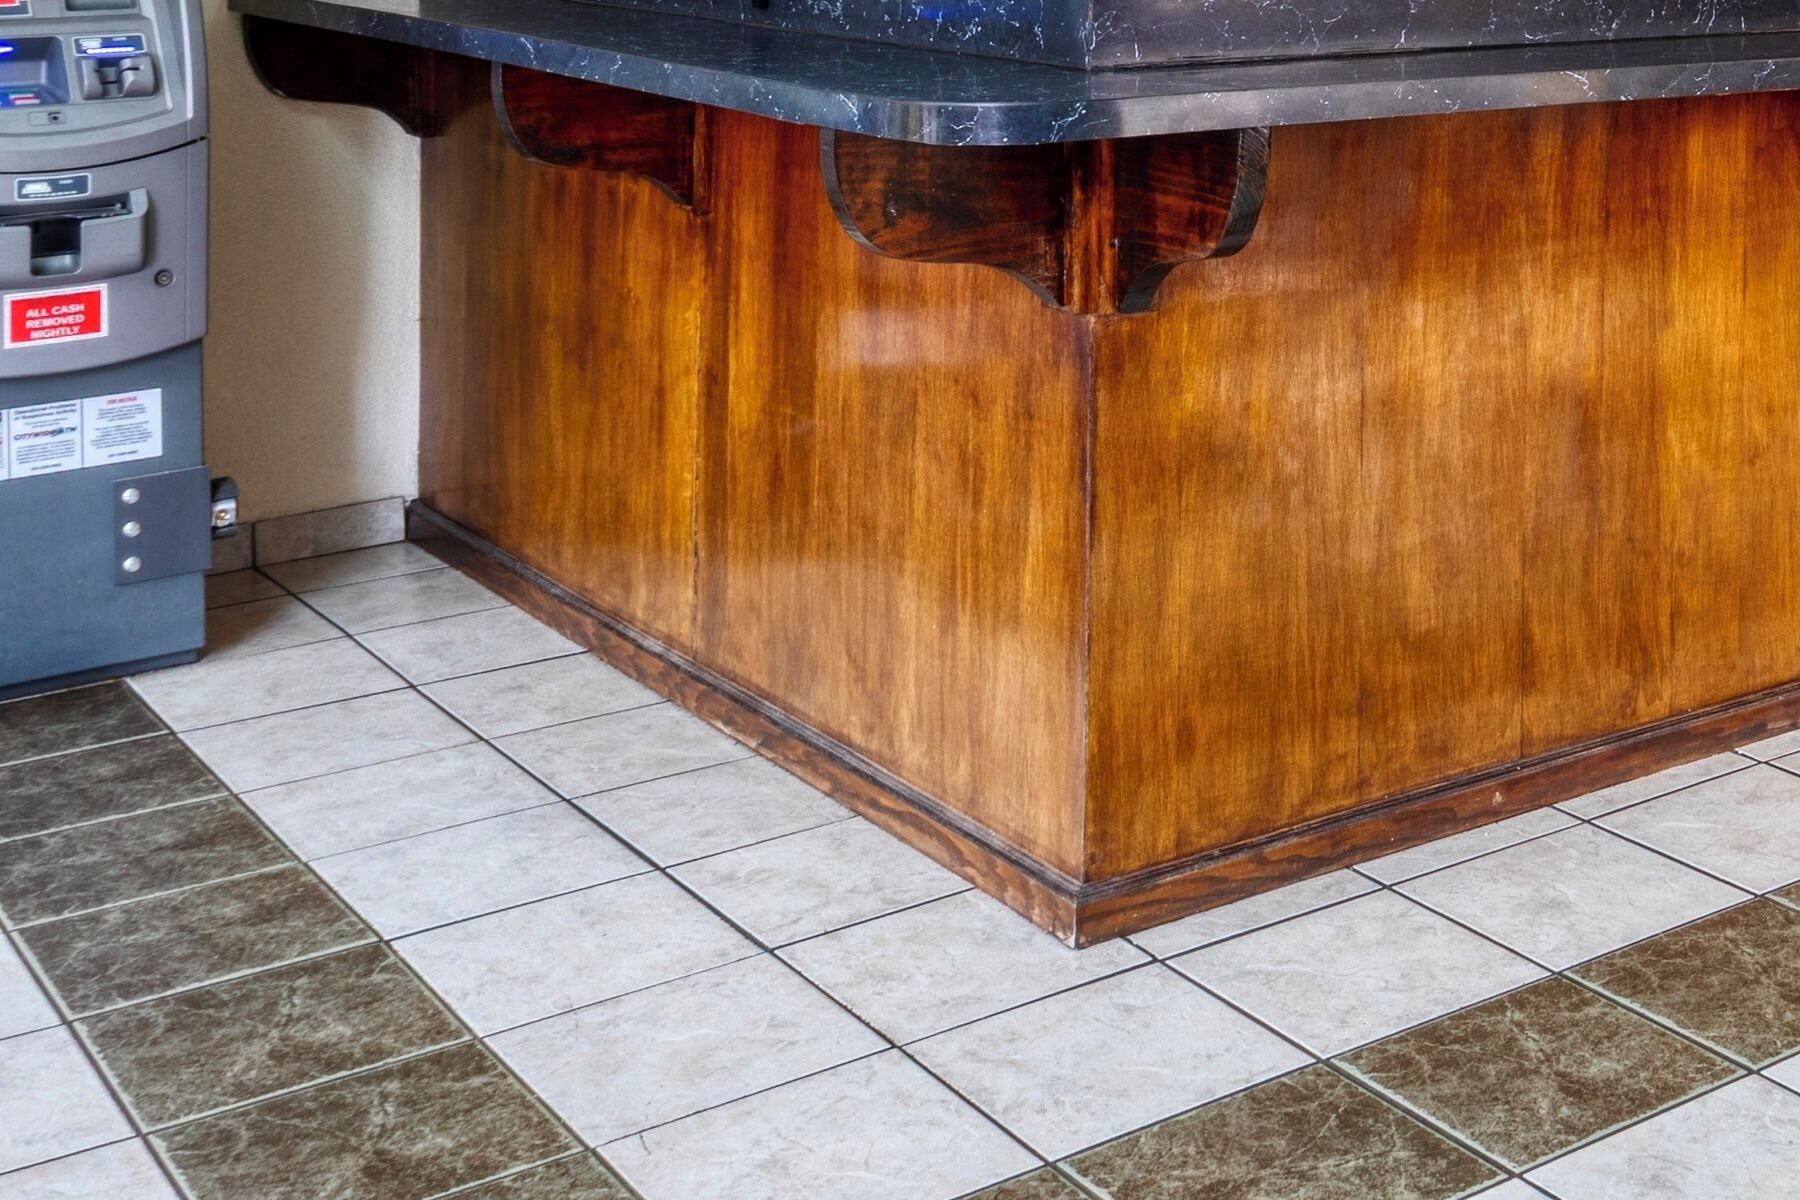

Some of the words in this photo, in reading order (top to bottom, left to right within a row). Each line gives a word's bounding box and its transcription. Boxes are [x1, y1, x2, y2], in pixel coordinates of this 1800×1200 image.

[25, 307, 49, 319] ALL
[51, 303, 86, 316] CASH
[25, 314, 86, 329] REMOVED
[29, 326, 81, 340] NIGHTLY
